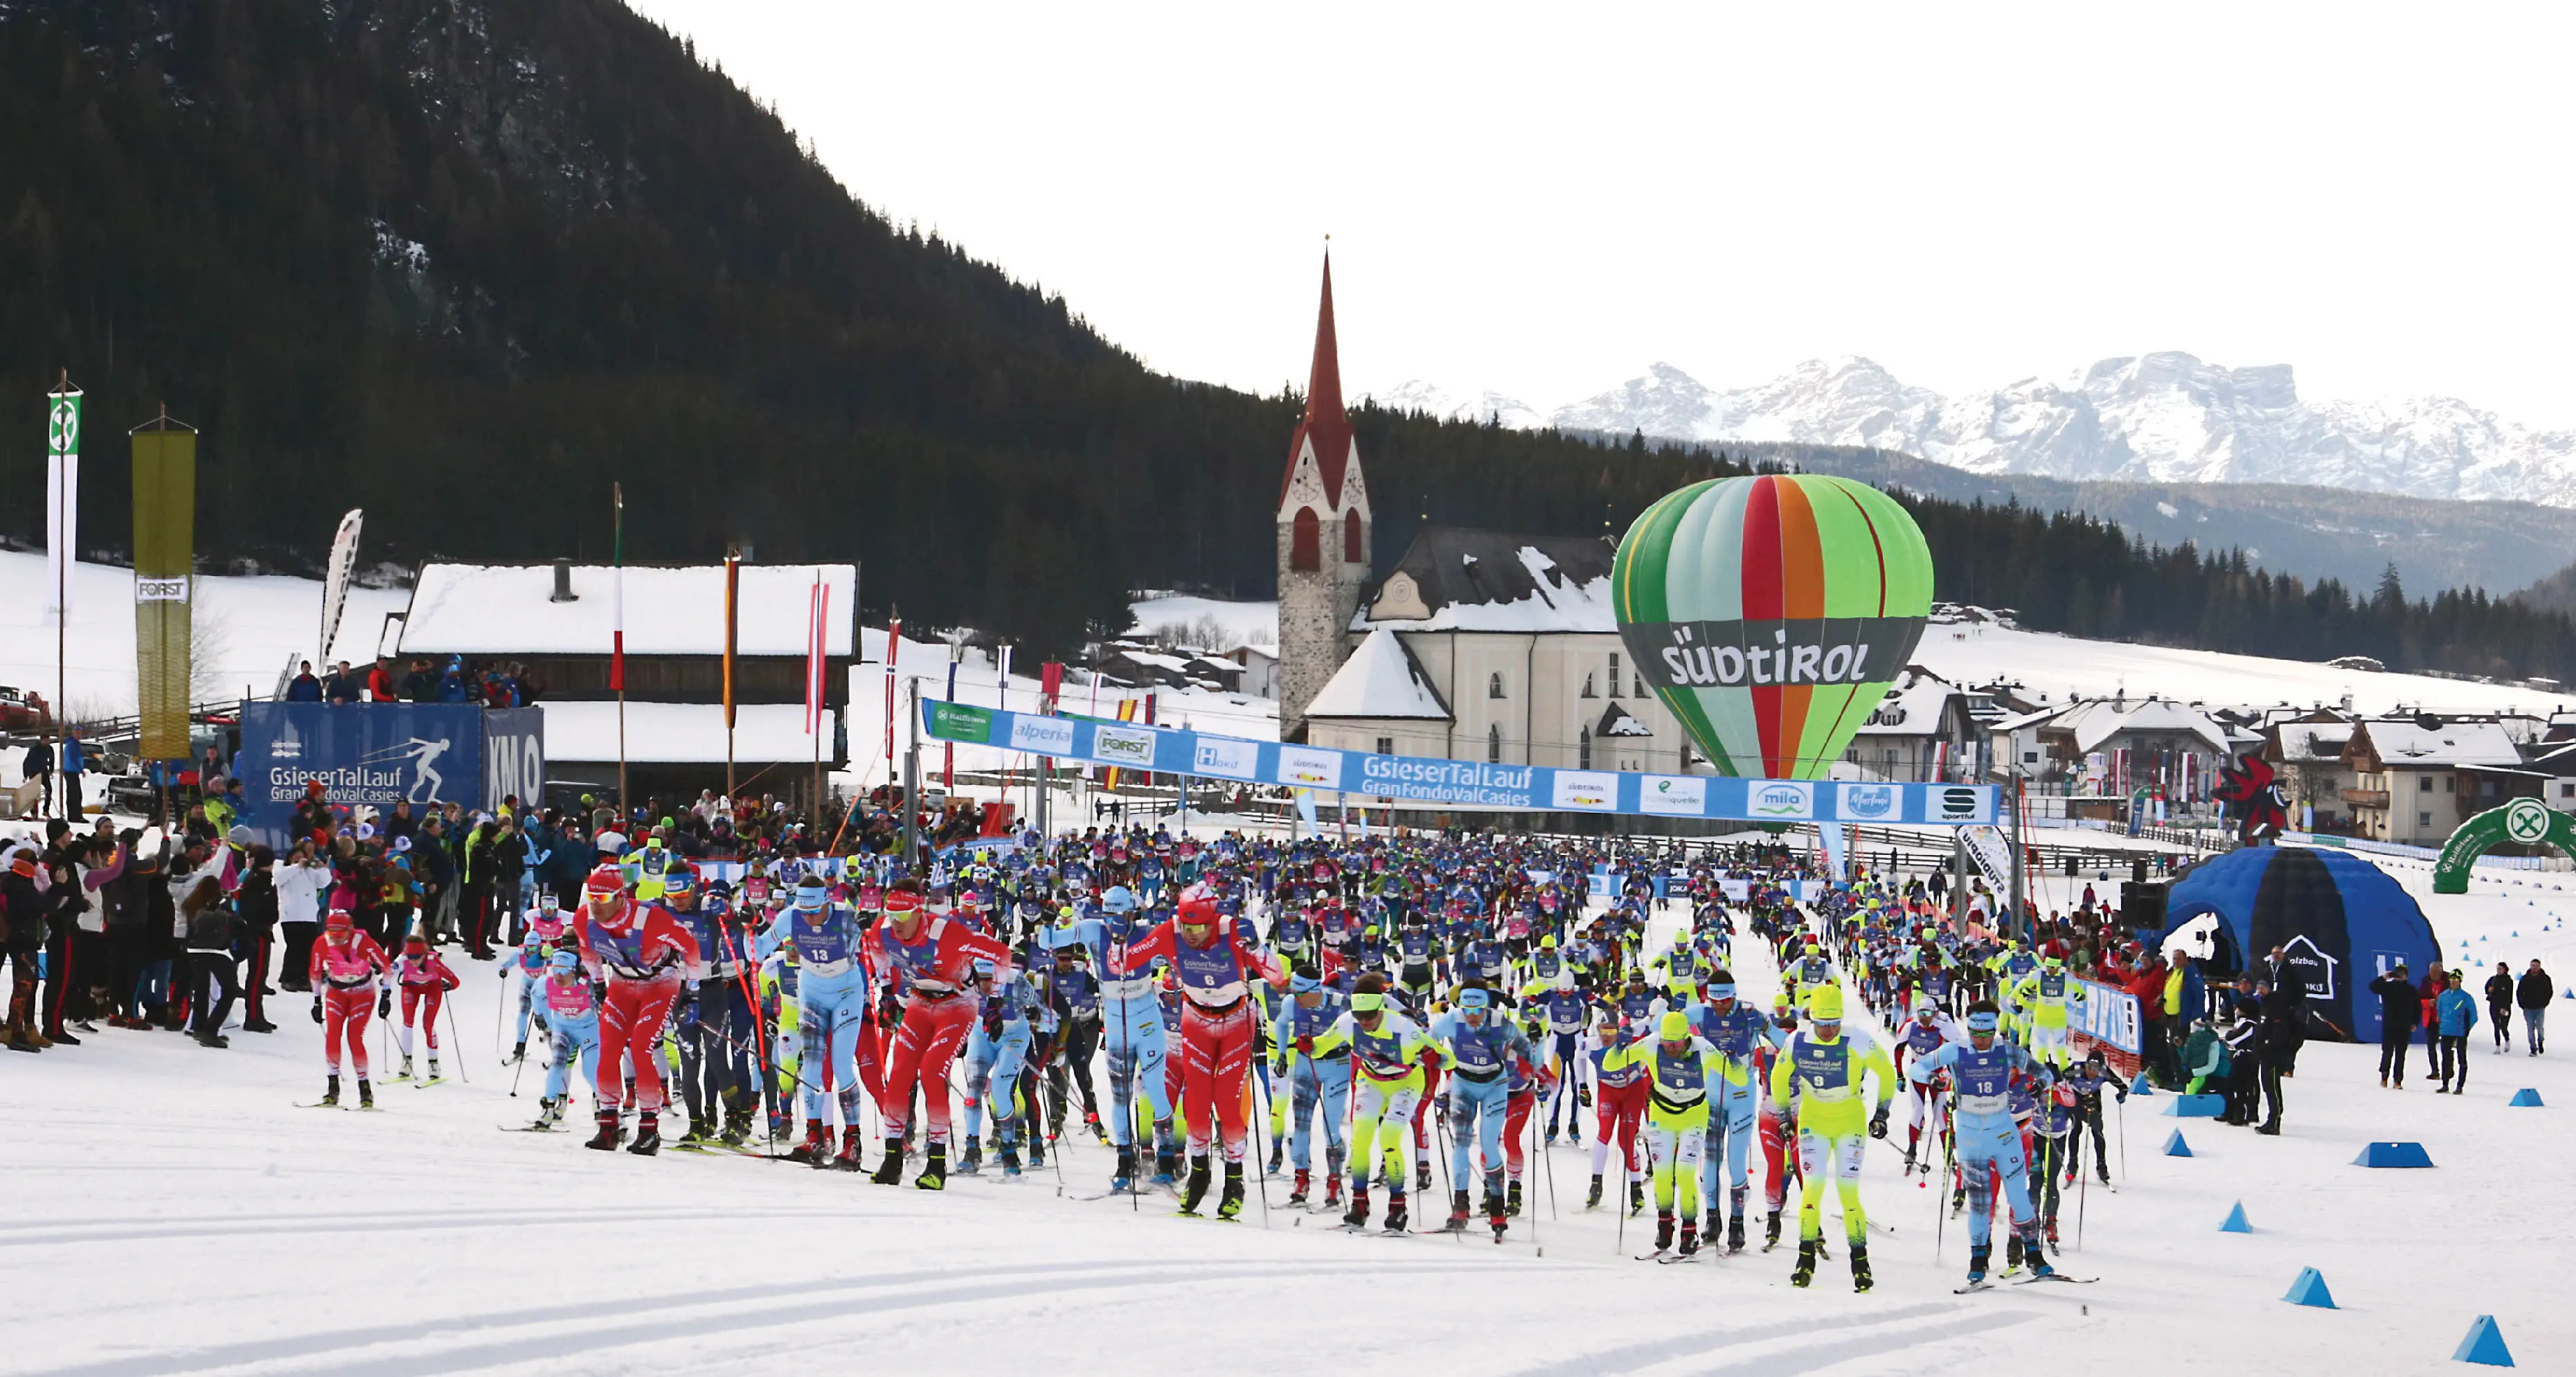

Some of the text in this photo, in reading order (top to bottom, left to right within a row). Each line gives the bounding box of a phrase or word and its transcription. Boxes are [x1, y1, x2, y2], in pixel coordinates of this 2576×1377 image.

[139, 582, 184, 596] FORST
[1014, 723, 1071, 741] alperia
[1102, 737, 1147, 753] FORST
[1361, 779, 1531, 807] GranFondoValCasies
[1764, 791, 1800, 804] mila
[812, 949, 829, 961] 13
[1204, 975, 1215, 986] 6
[645, 994, 677, 1055] Internorm
[1560, 1014, 1571, 1023] 50
[938, 1021, 974, 1078] Internorm
[1976, 1081, 1993, 1094] 18
